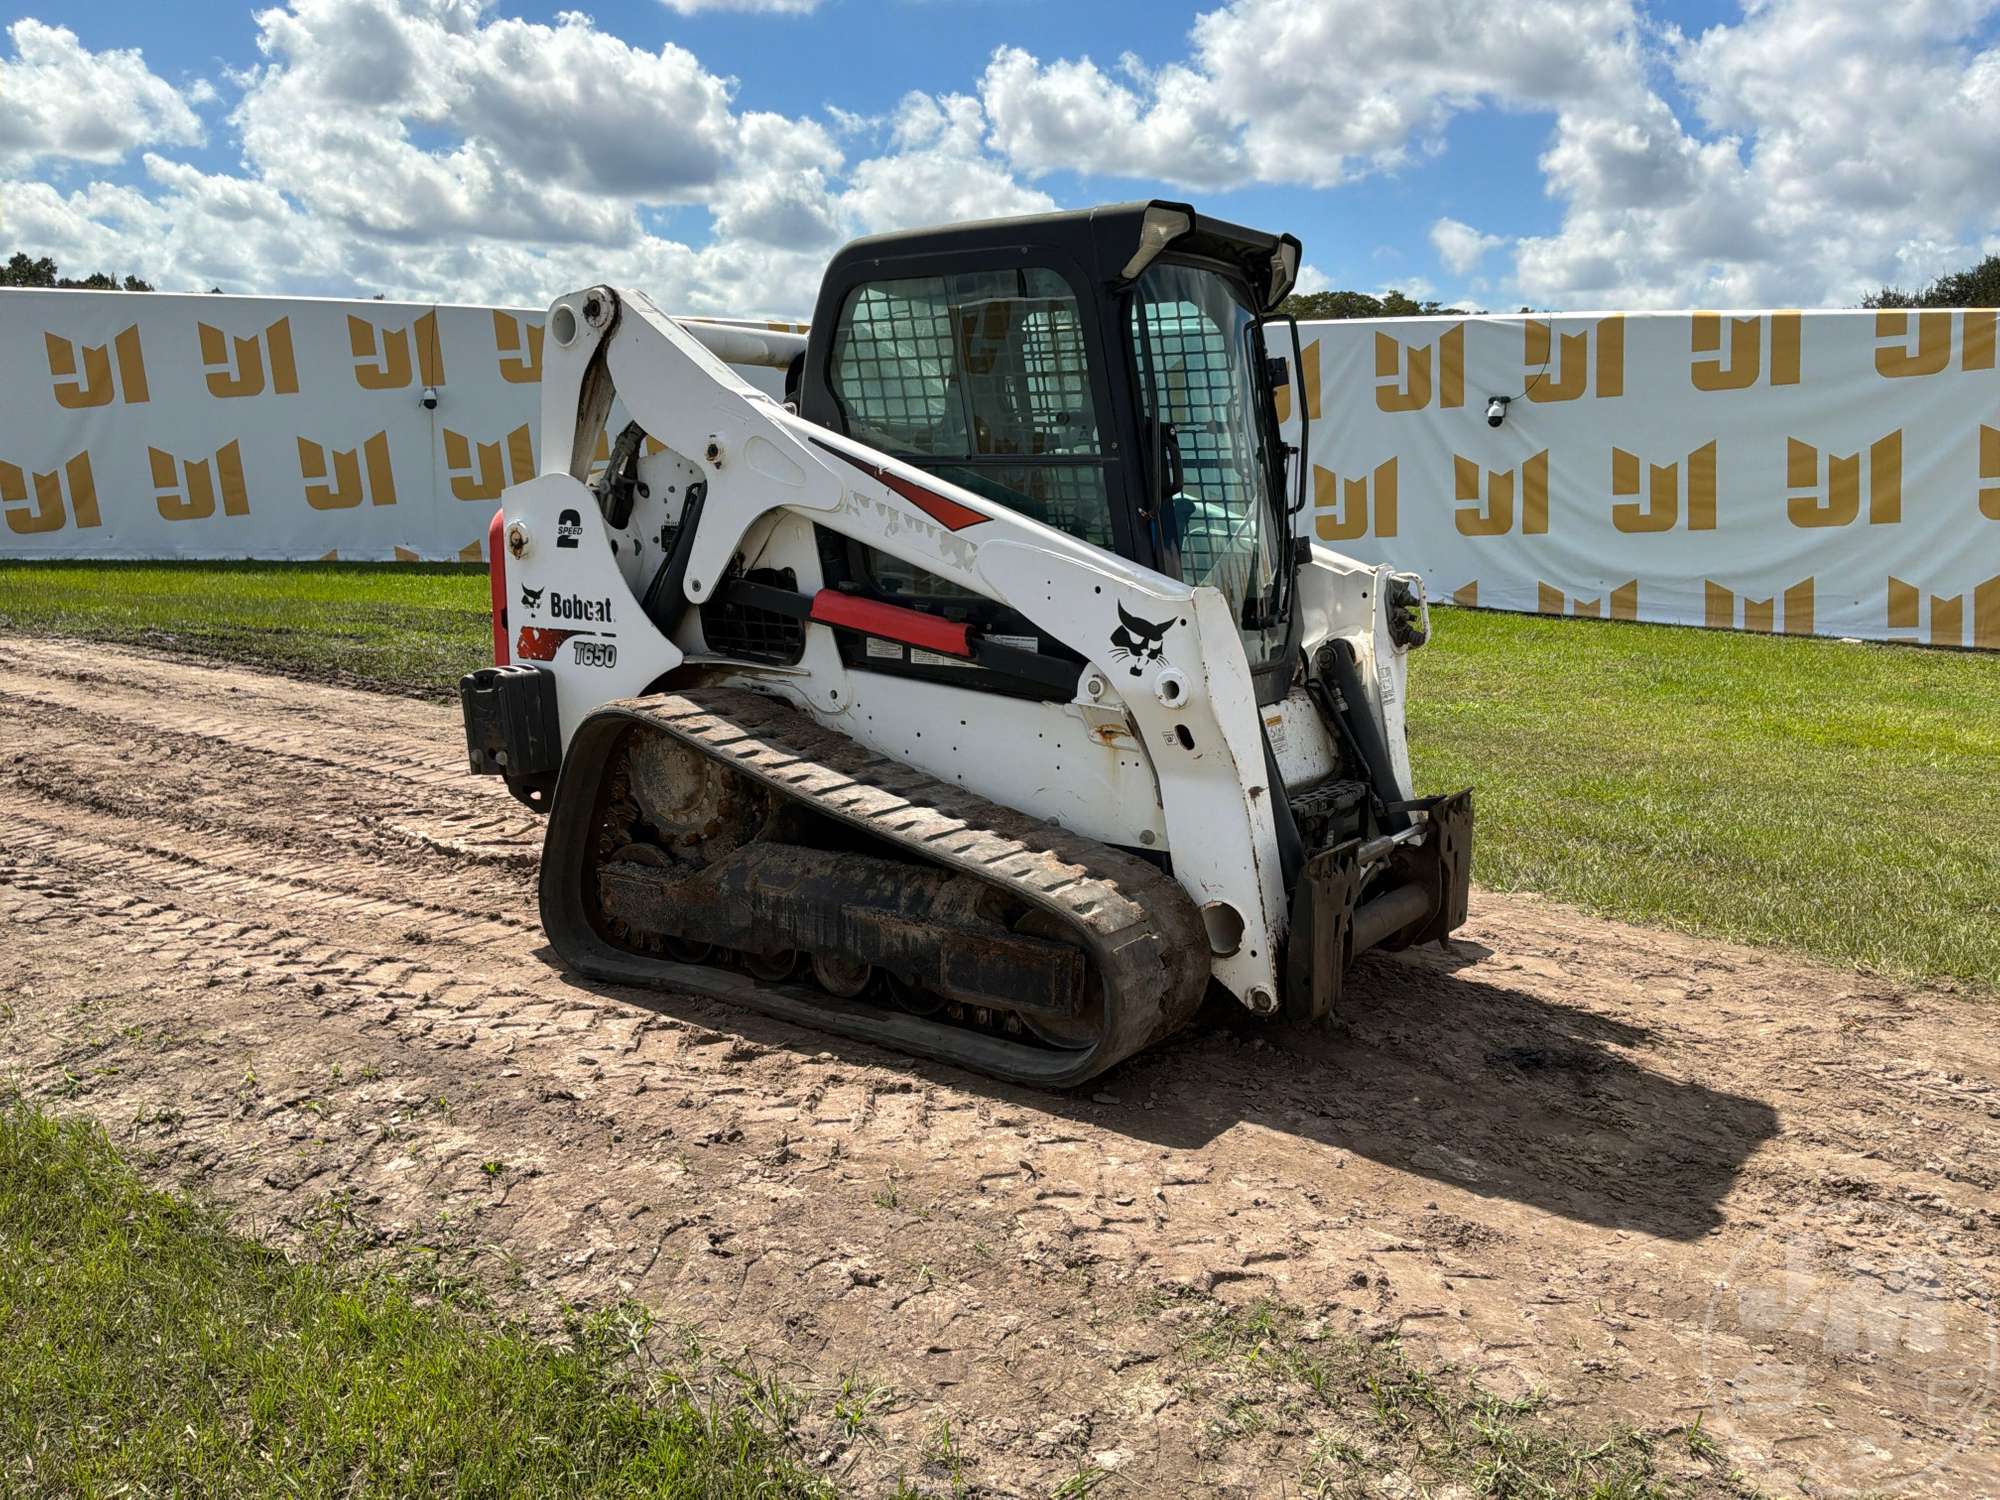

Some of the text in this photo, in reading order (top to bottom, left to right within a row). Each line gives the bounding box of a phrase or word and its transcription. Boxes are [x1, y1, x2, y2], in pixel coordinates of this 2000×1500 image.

[557, 509, 581, 548] 2
[558, 526, 583, 535] SPEED
[551, 592, 614, 622] Bobcat
[574, 641, 617, 668] T650
